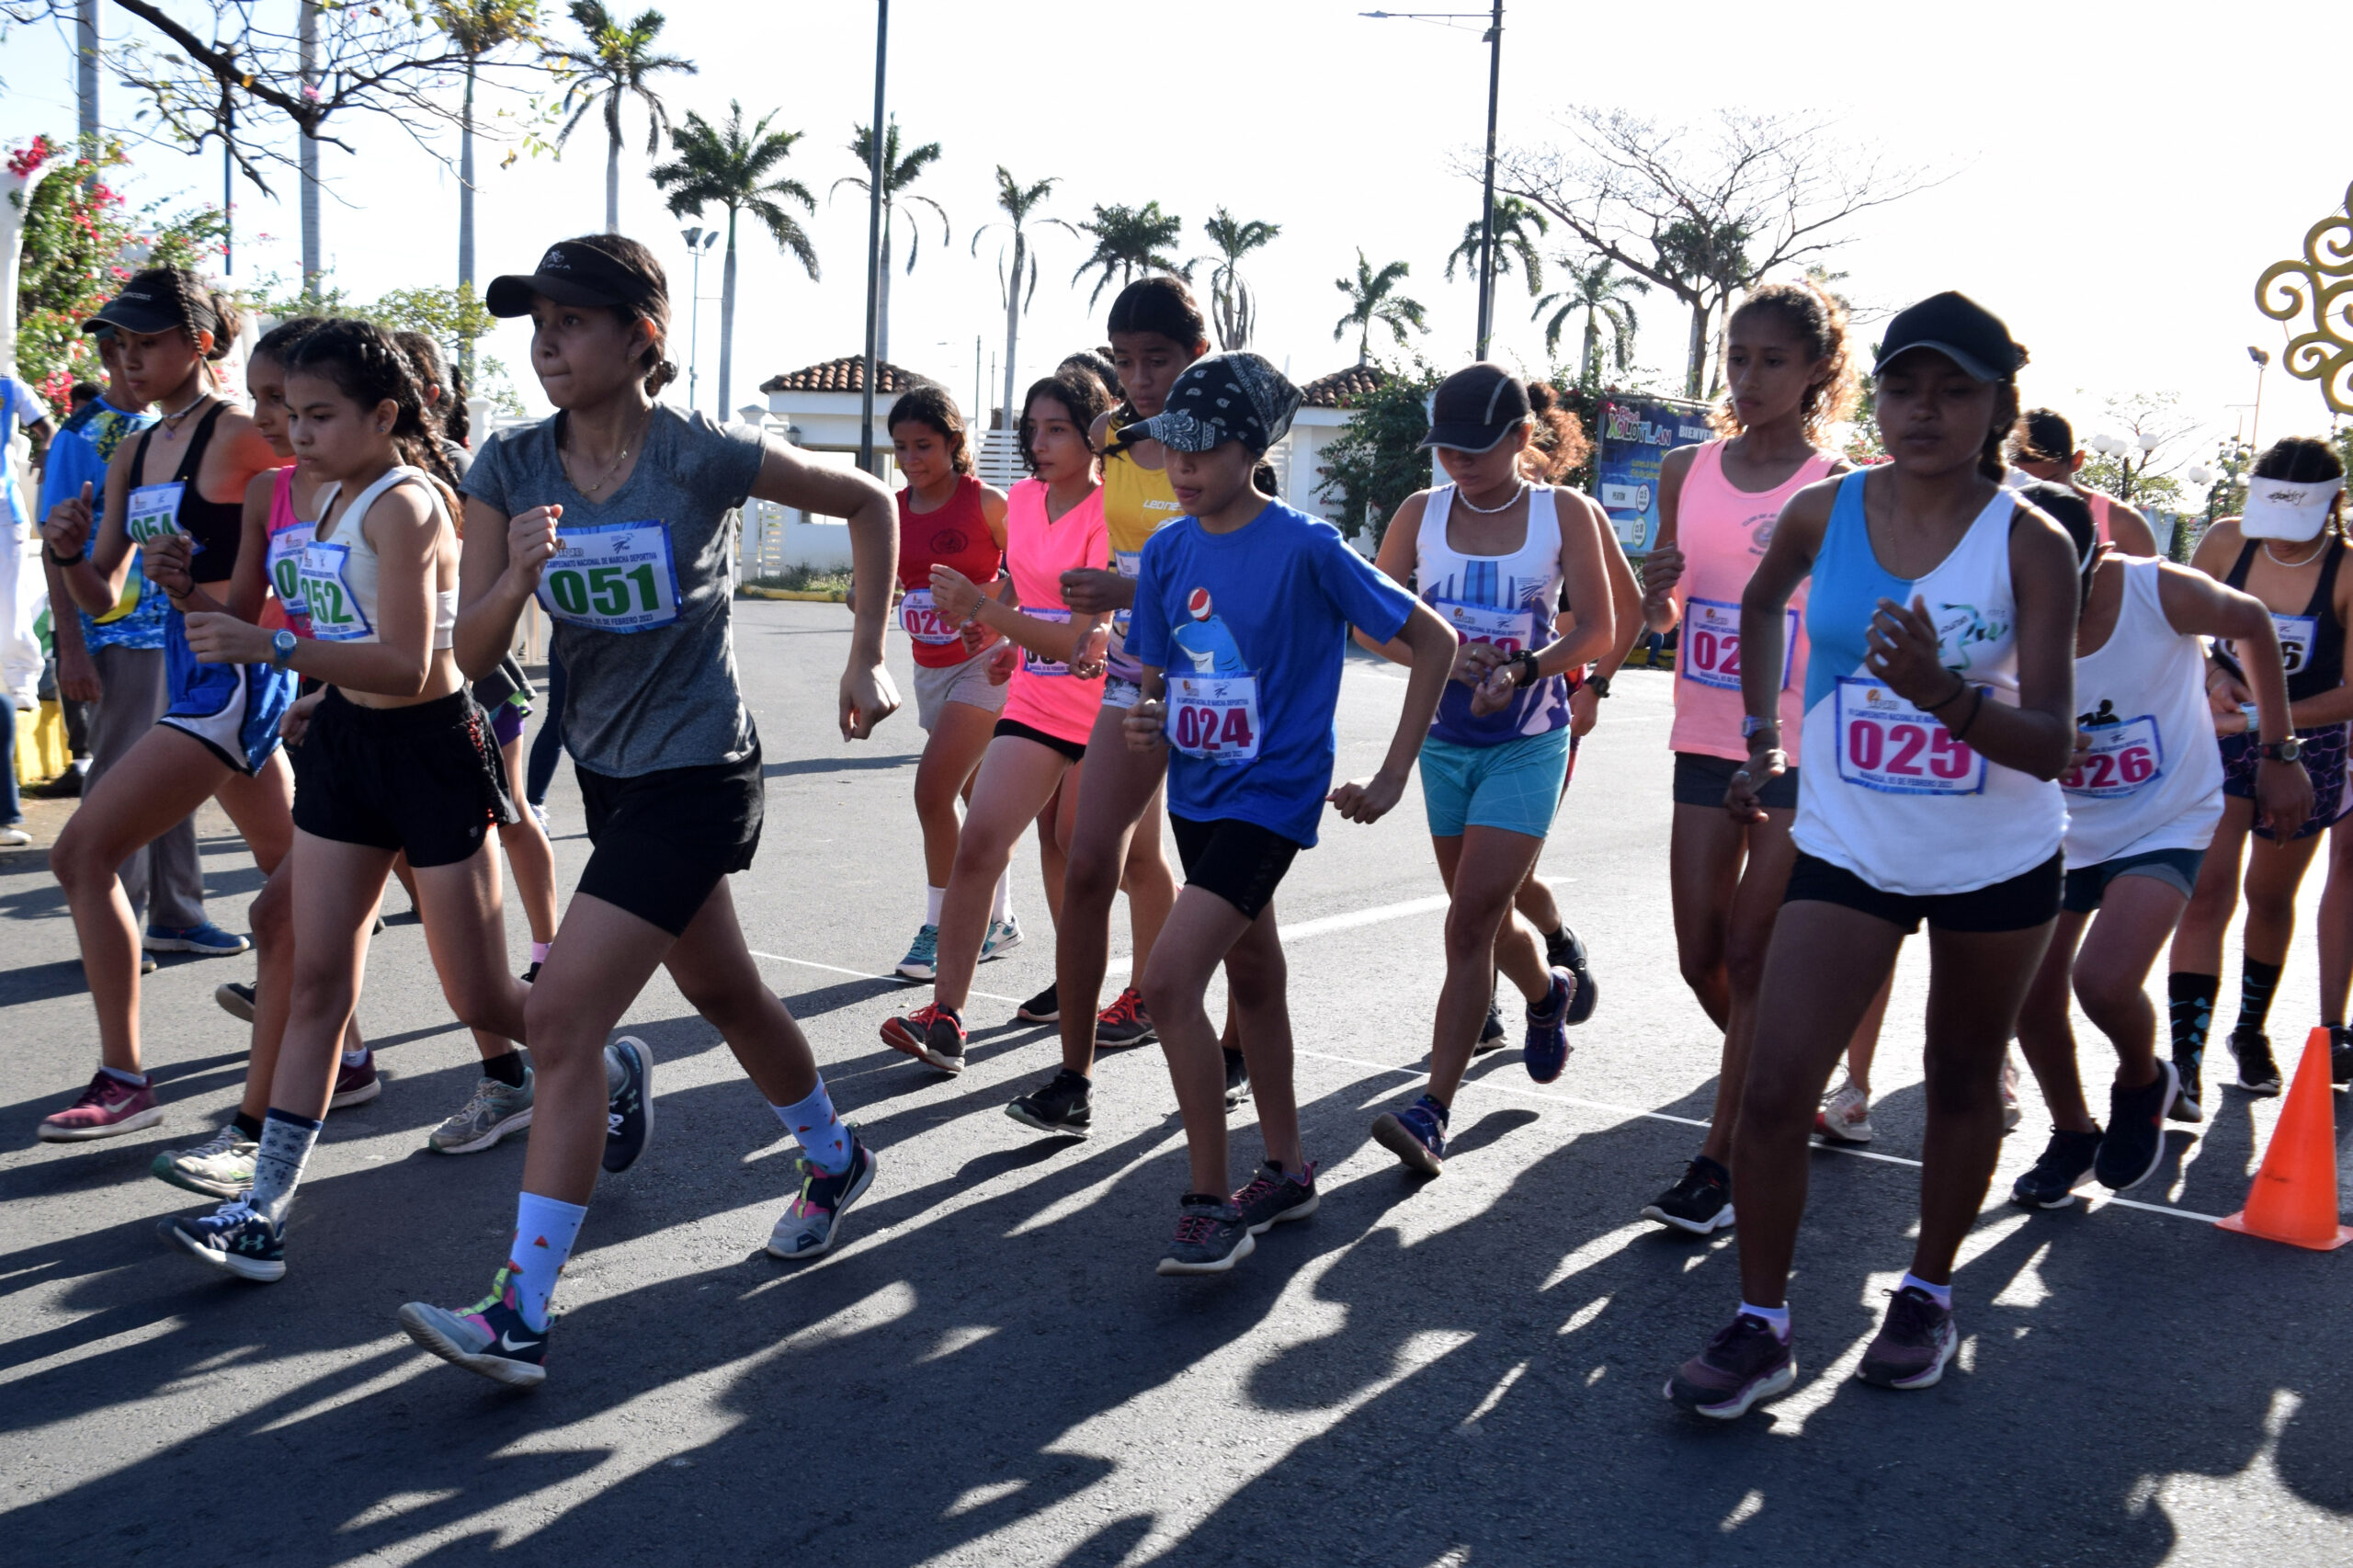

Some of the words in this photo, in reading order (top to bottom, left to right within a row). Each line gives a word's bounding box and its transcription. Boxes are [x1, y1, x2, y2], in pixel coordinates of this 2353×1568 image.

[576, 558, 601, 567] NACIONAL
[601, 557, 609, 565] DE
[608, 555, 630, 564] MARCHA
[629, 551, 658, 562] DEPORTIVA
[301, 577, 355, 624] 052
[549, 563, 660, 616] 051
[1694, 631, 1741, 676] 02
[1176, 705, 1254, 750] 024
[1849, 720, 1972, 778] 025
